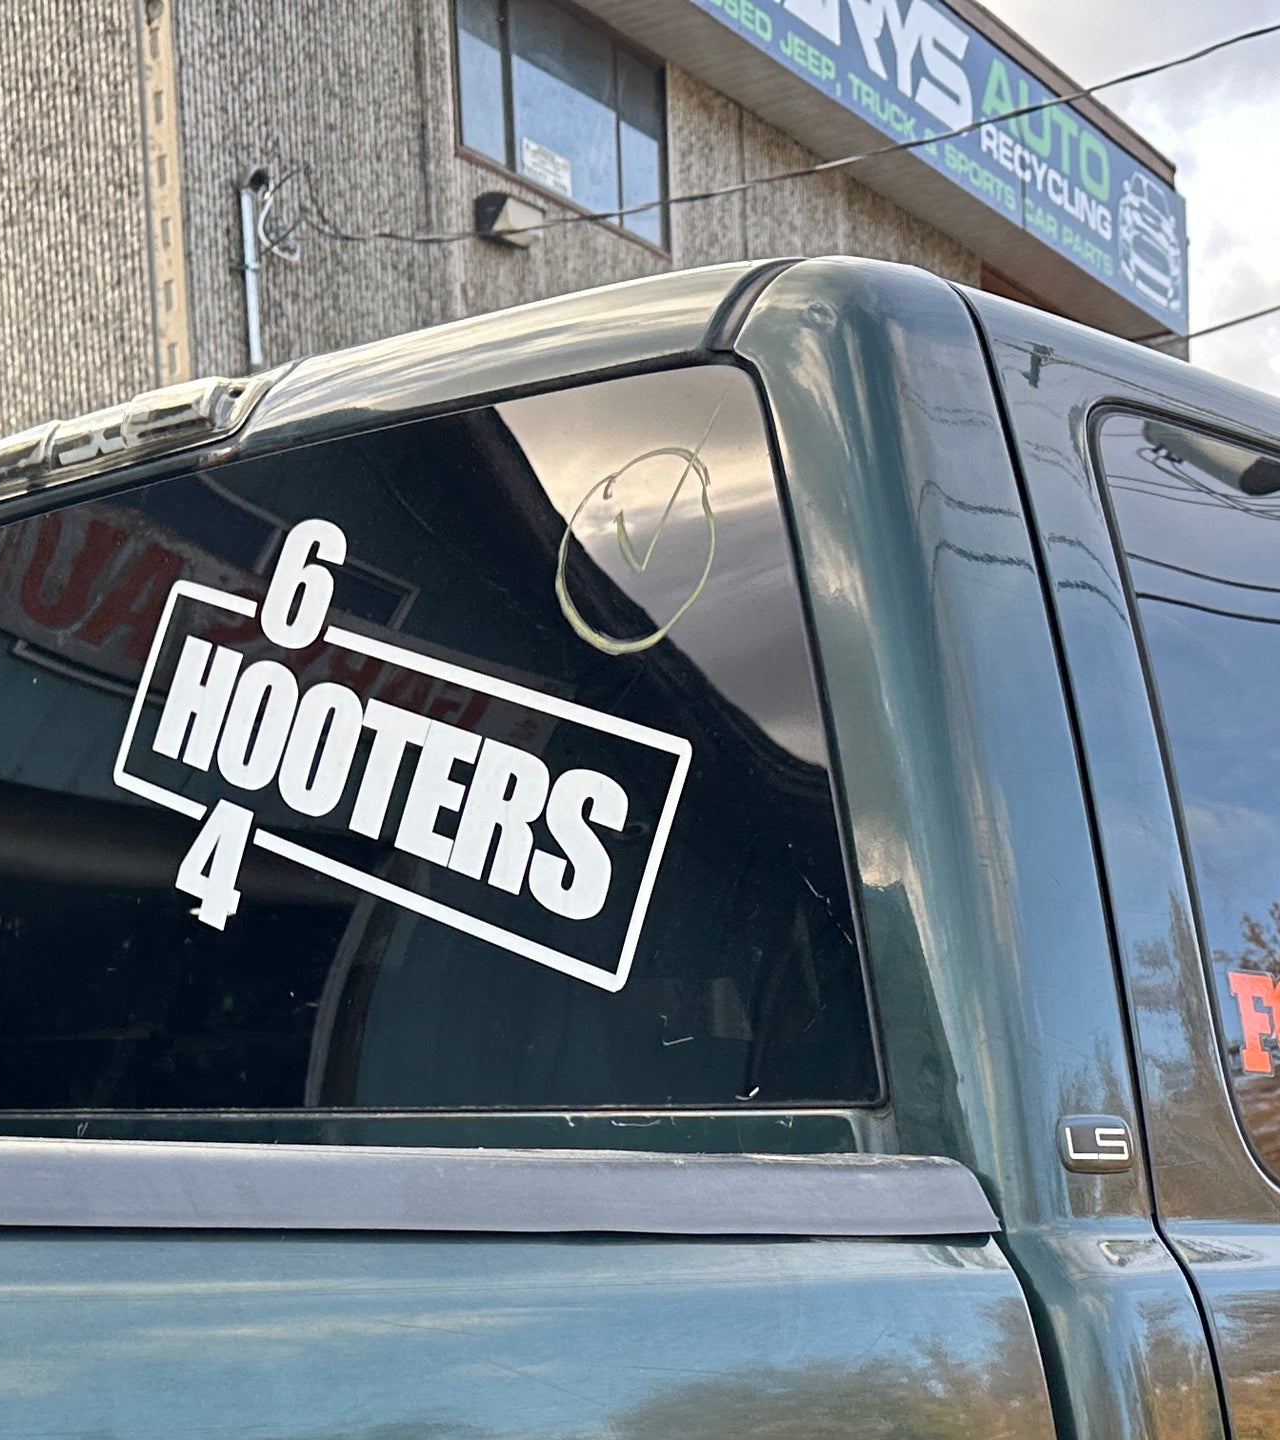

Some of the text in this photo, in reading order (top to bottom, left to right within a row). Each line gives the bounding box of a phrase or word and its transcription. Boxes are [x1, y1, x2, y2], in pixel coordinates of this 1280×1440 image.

[709, 0, 772, 42] SED
[848, 72, 917, 139] TRUCK
[944, 142, 1017, 211] SPORTS
[1024, 197, 1058, 237] CAR
[1062, 224, 1114, 277] PARTS
[980, 117, 1112, 241] RECYCLING
[982, 56, 1110, 202] AUTO
[260, 518, 348, 650] 6
[152, 635, 629, 922] HOOTERS
[175, 799, 255, 931] 4
[1065, 1127, 1130, 1161] LS
